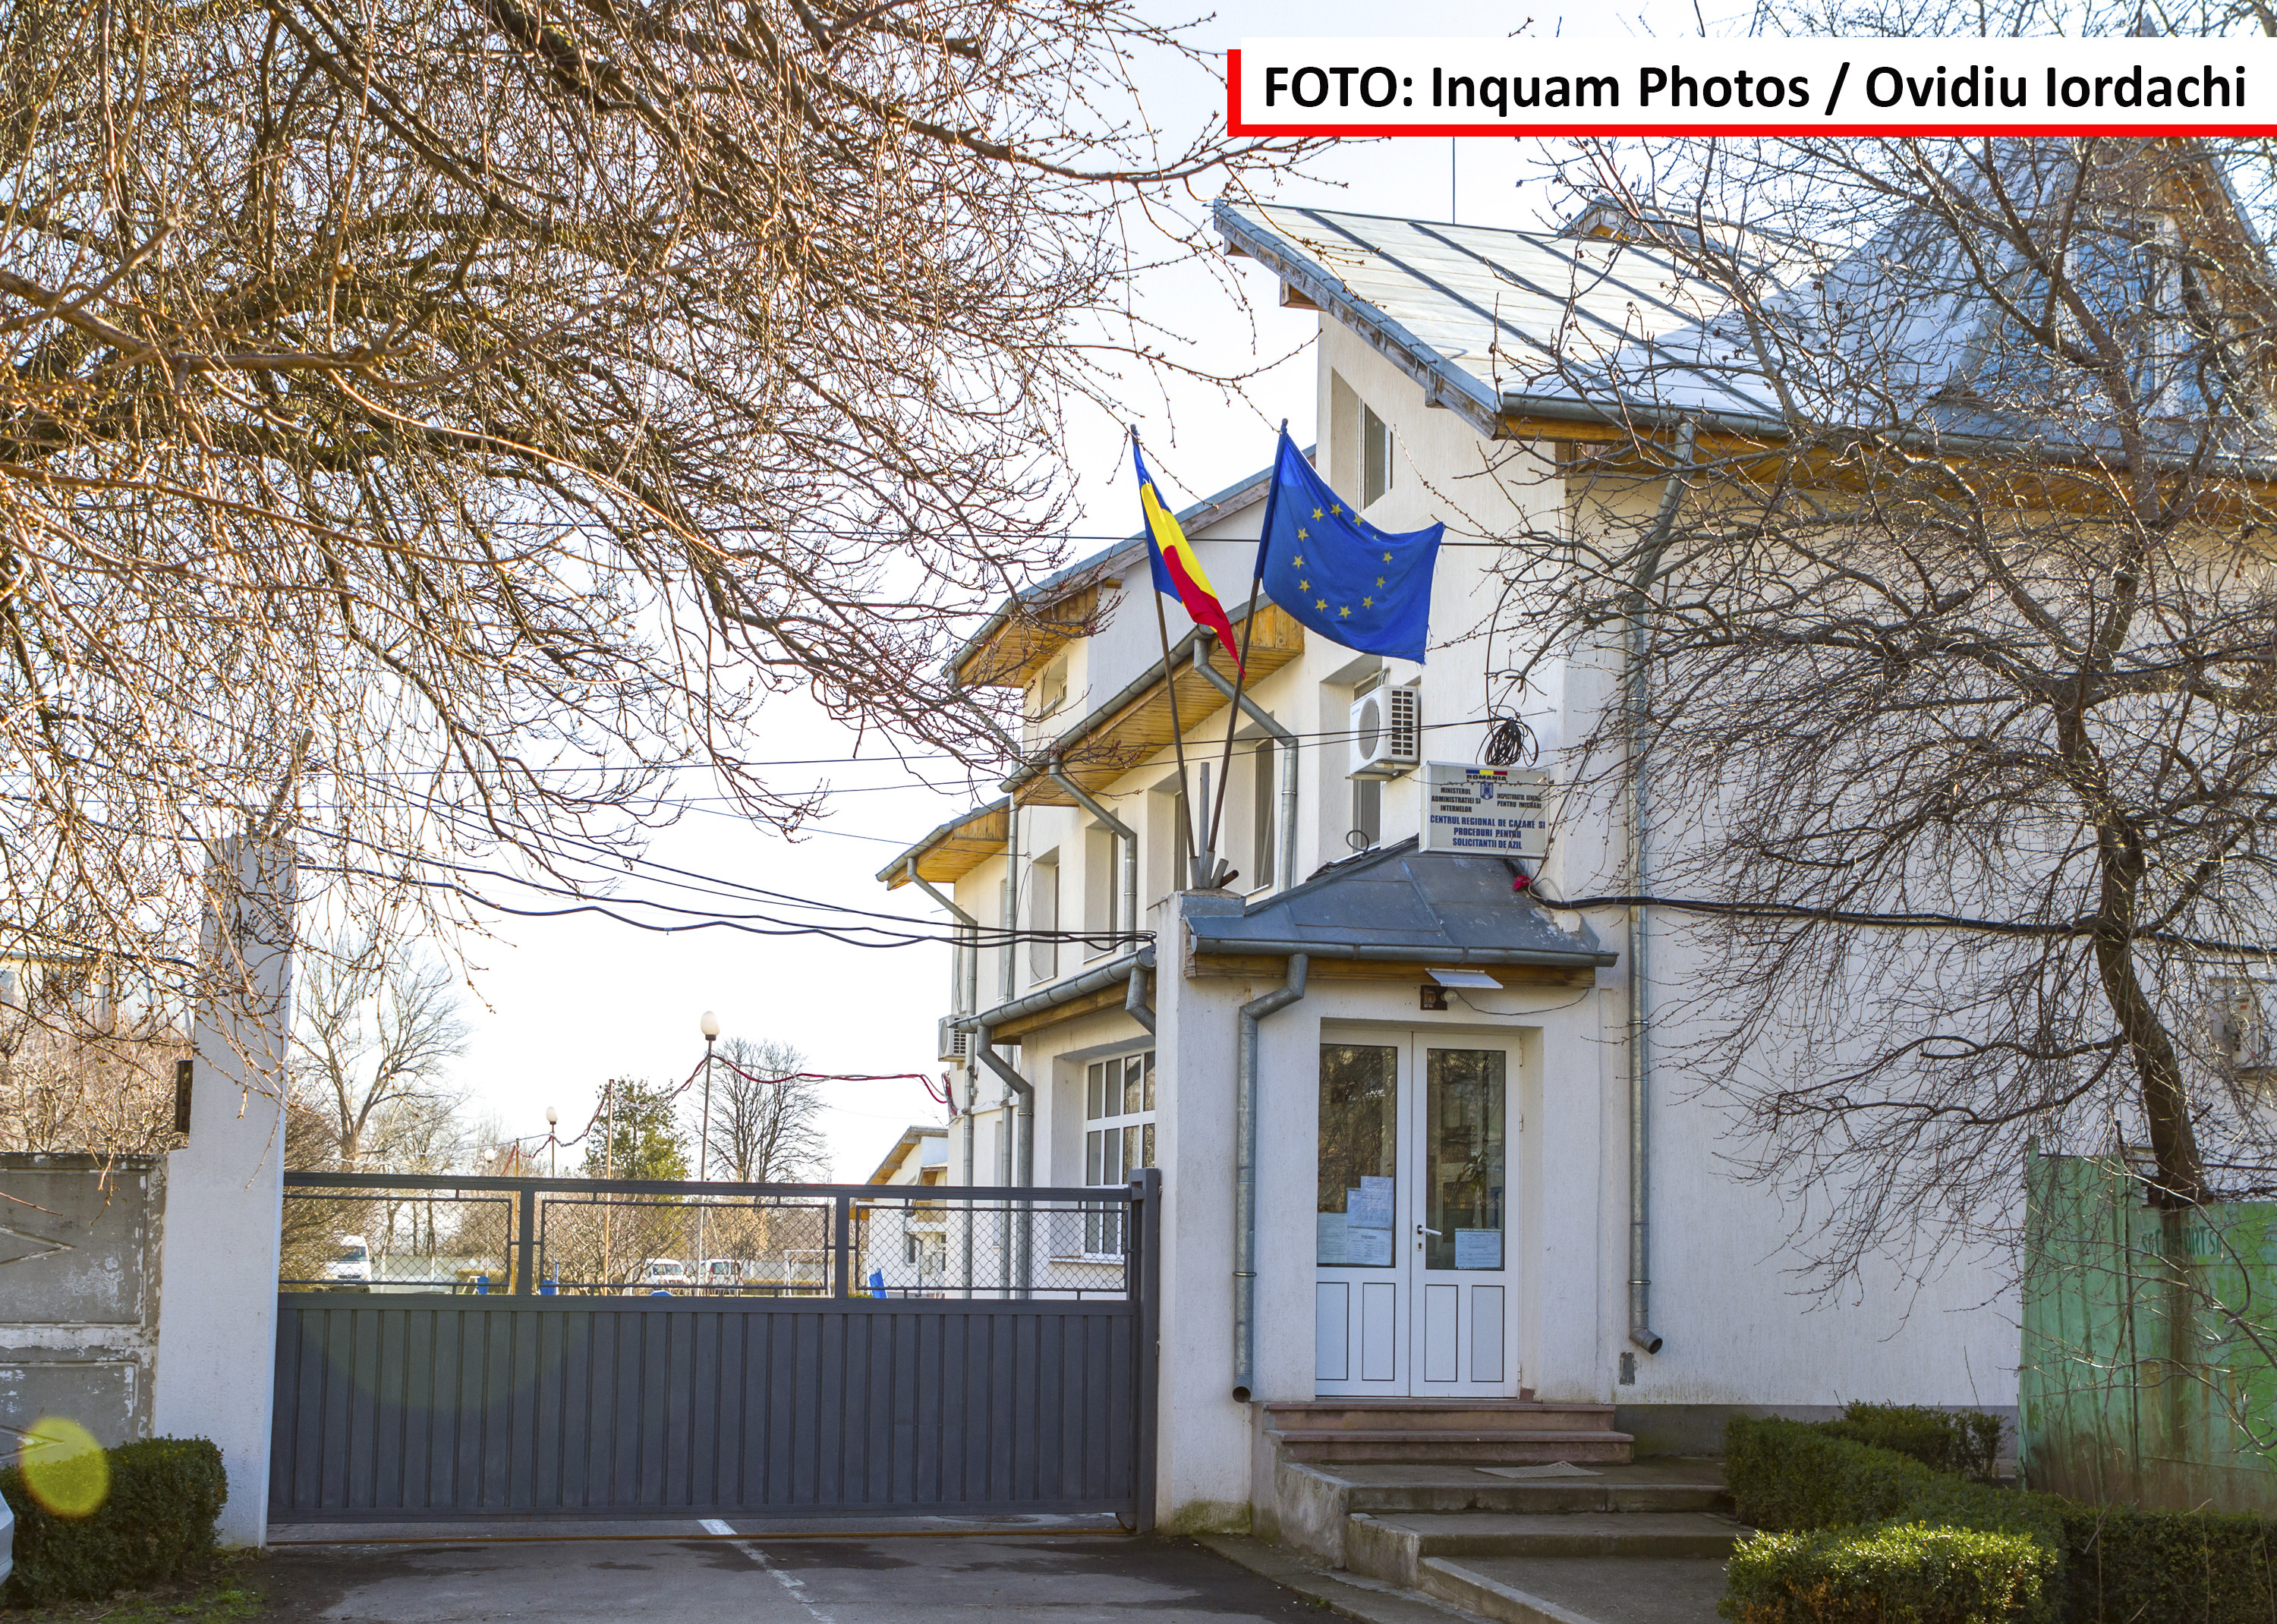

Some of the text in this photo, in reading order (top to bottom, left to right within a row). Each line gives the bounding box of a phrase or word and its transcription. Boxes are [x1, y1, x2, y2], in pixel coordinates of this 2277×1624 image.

[1431, 795, 1474, 804] ADMINISTRATIEI
[1430, 815, 1460, 825] CENTRUL
[1462, 817, 1495, 826] REGIONAL
[1498, 819, 1507, 827] DE
[1509, 820, 1535, 829] CAZARE
[1453, 827, 1521, 838] PROCEDURI PENTRU
[1453, 838, 1522, 849] SOLICITANTII DE AZIL
